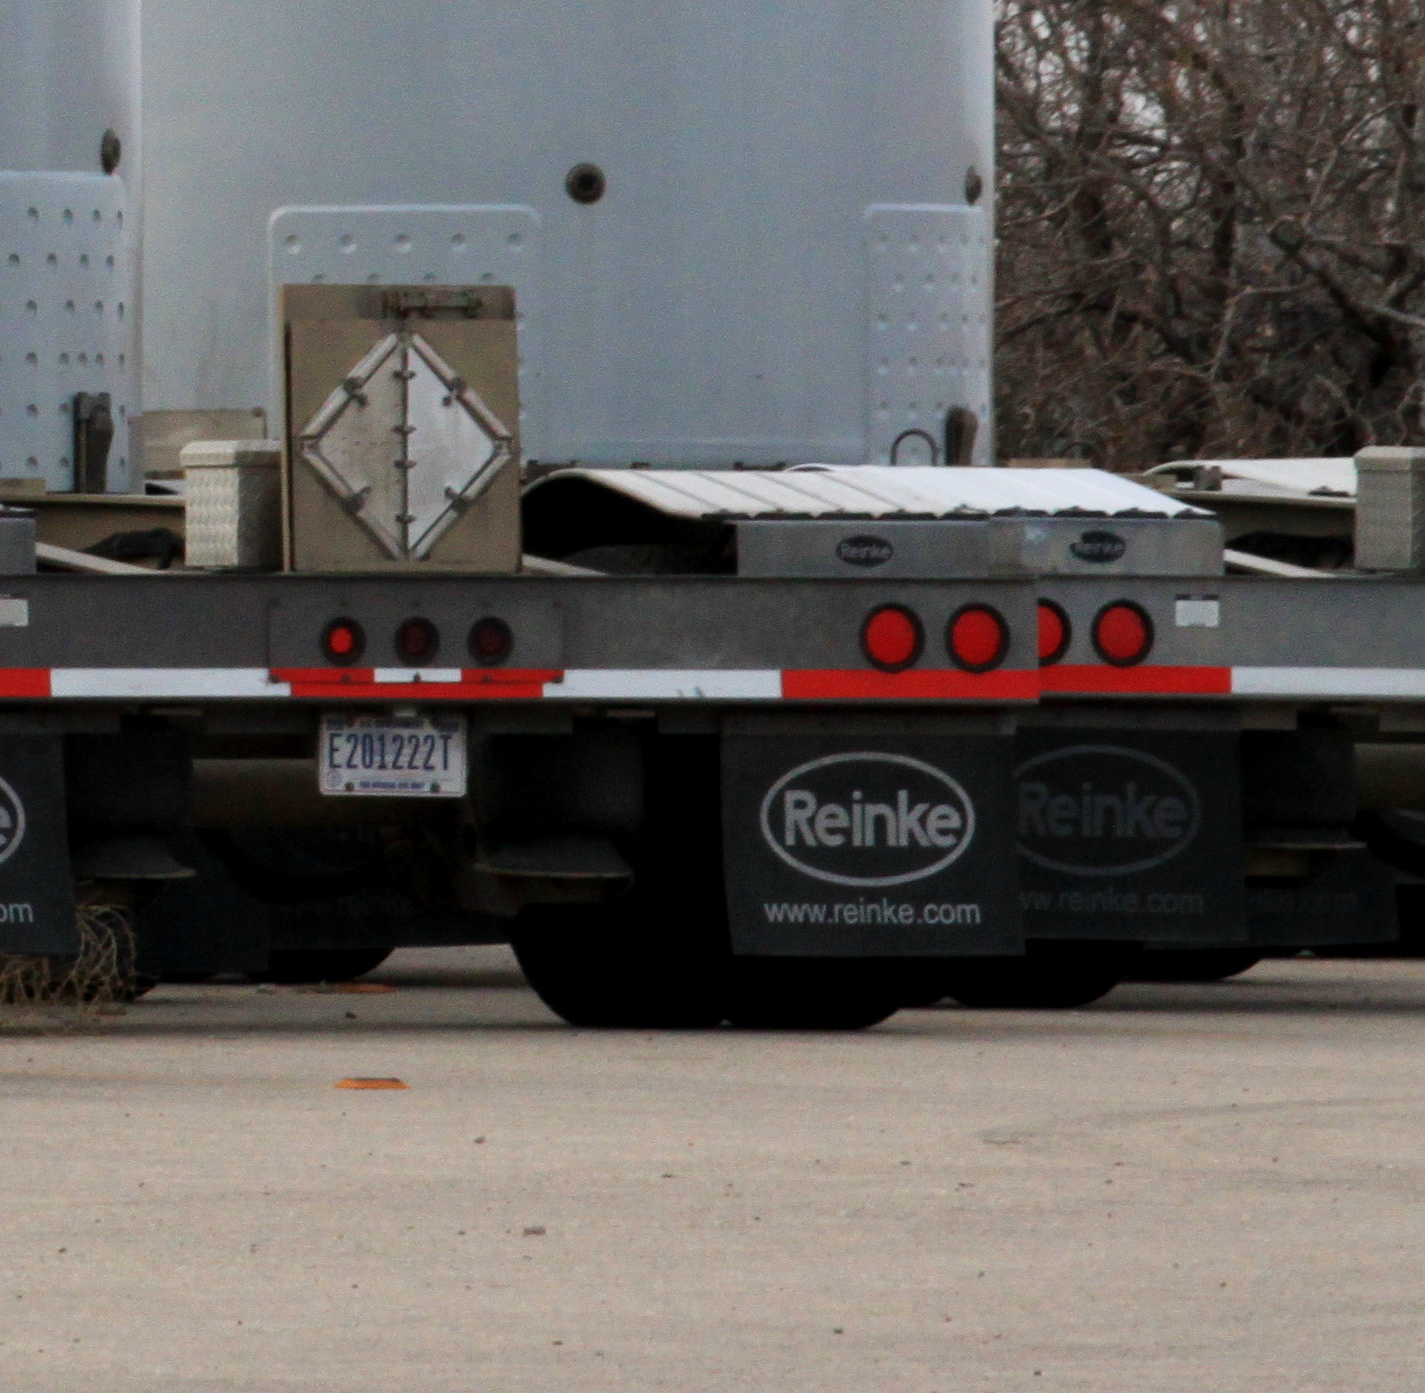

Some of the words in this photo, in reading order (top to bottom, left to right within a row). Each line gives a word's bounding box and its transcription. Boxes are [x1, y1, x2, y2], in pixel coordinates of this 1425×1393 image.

[329, 732, 452, 770] E201222T
[783, 789, 962, 848] Reinke
[1018, 780, 1190, 839] Reinke
[764, 897, 982, 927] www.reinke.com
